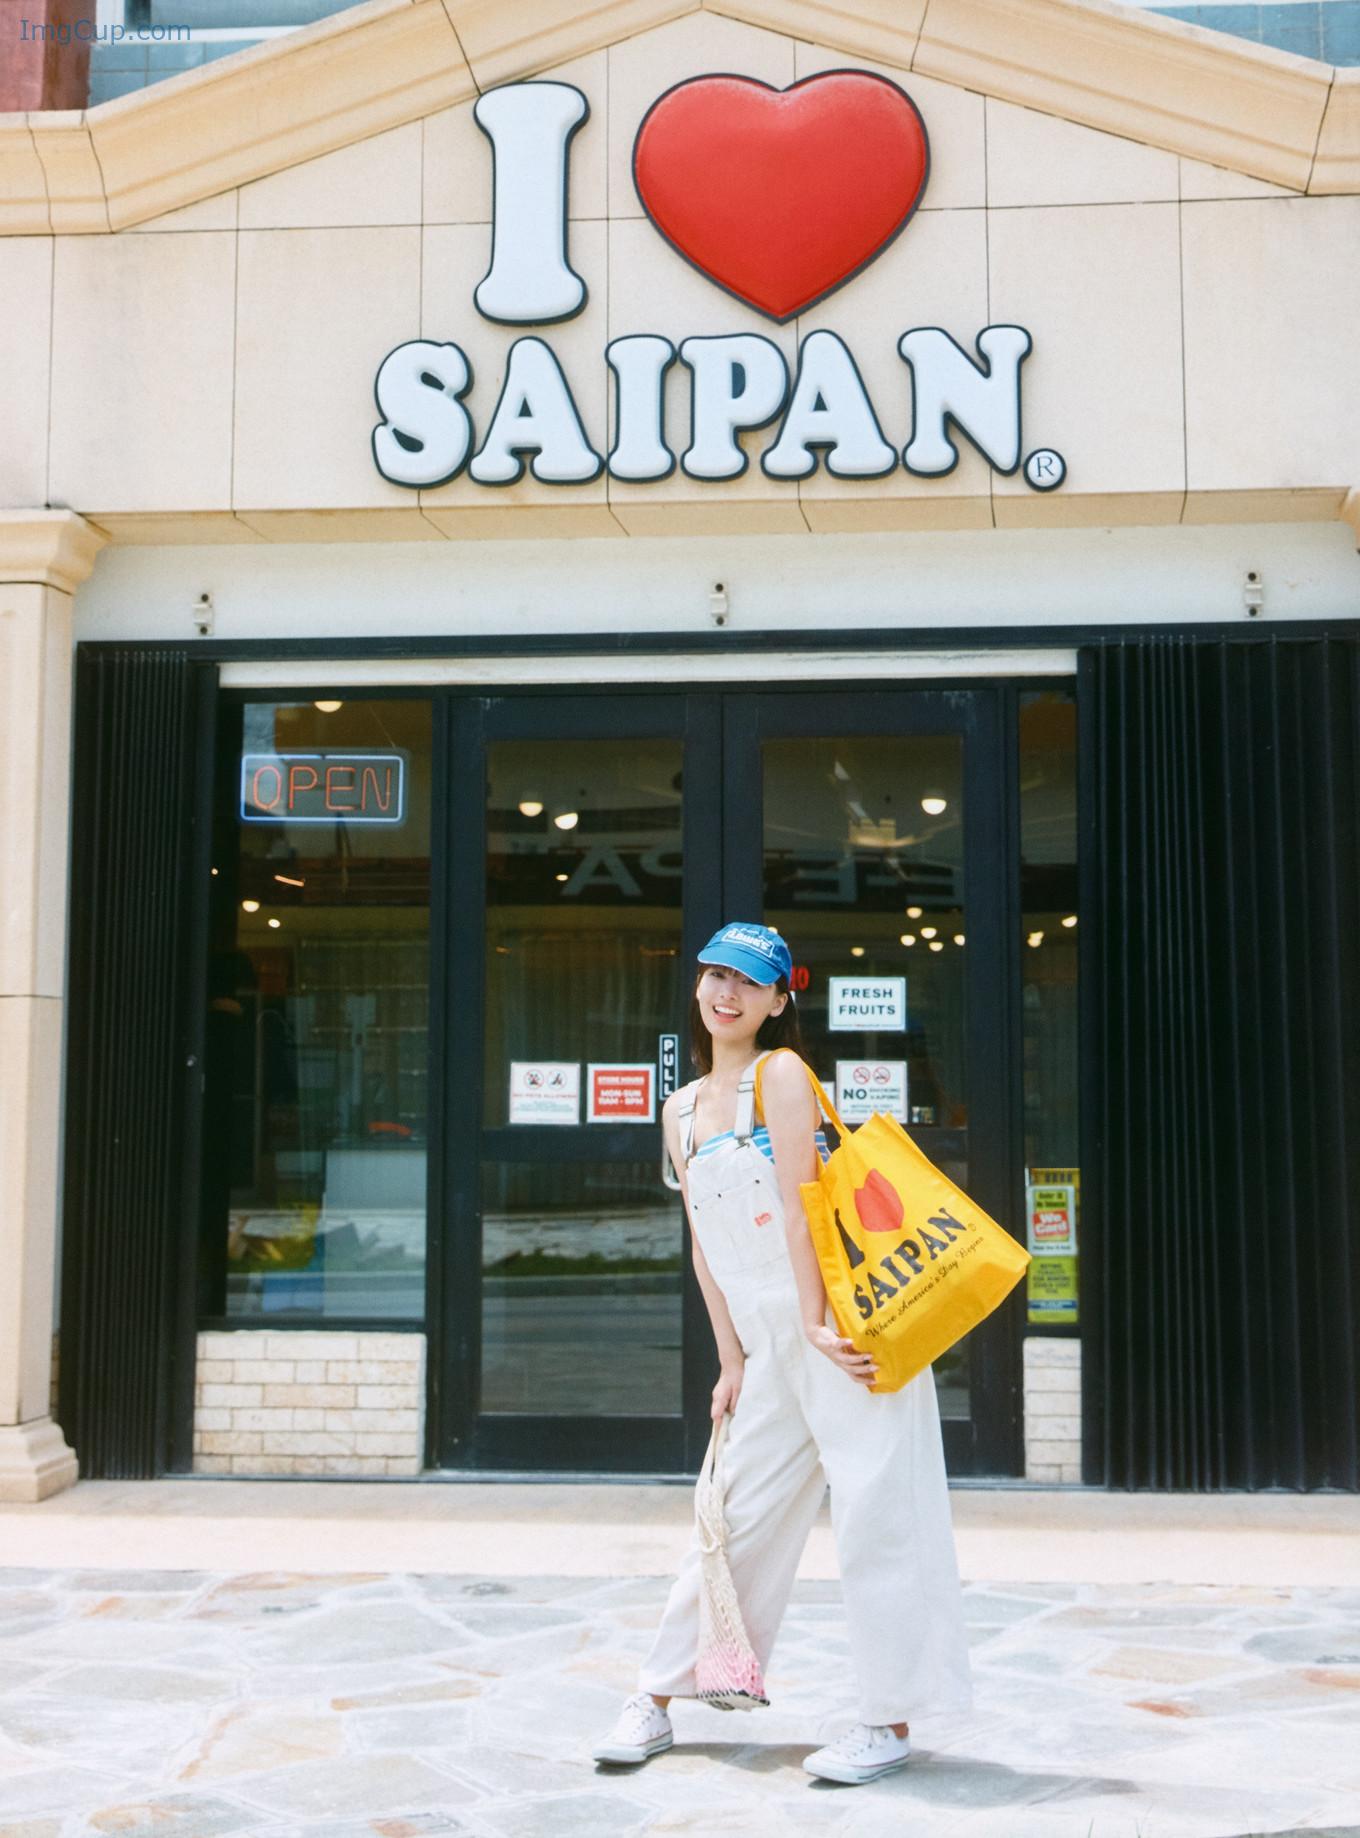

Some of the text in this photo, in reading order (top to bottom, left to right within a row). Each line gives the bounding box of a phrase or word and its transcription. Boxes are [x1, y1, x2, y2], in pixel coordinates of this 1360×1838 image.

[474, 81, 590, 326] I
[372, 325, 1032, 488] SAIPAN
[253, 764, 392, 812] OPEN
[839, 1004, 896, 1016] FRUITS
[841, 988, 893, 999] FRESH
[663, 1038, 674, 1096] PULL
[843, 1088, 867, 1100] NO
[854, 1207, 967, 1320] SAIPAN
[865, 1314, 896, 1338] Where
[898, 1276, 940, 1315] America's
[938, 1260, 959, 1277] Day
